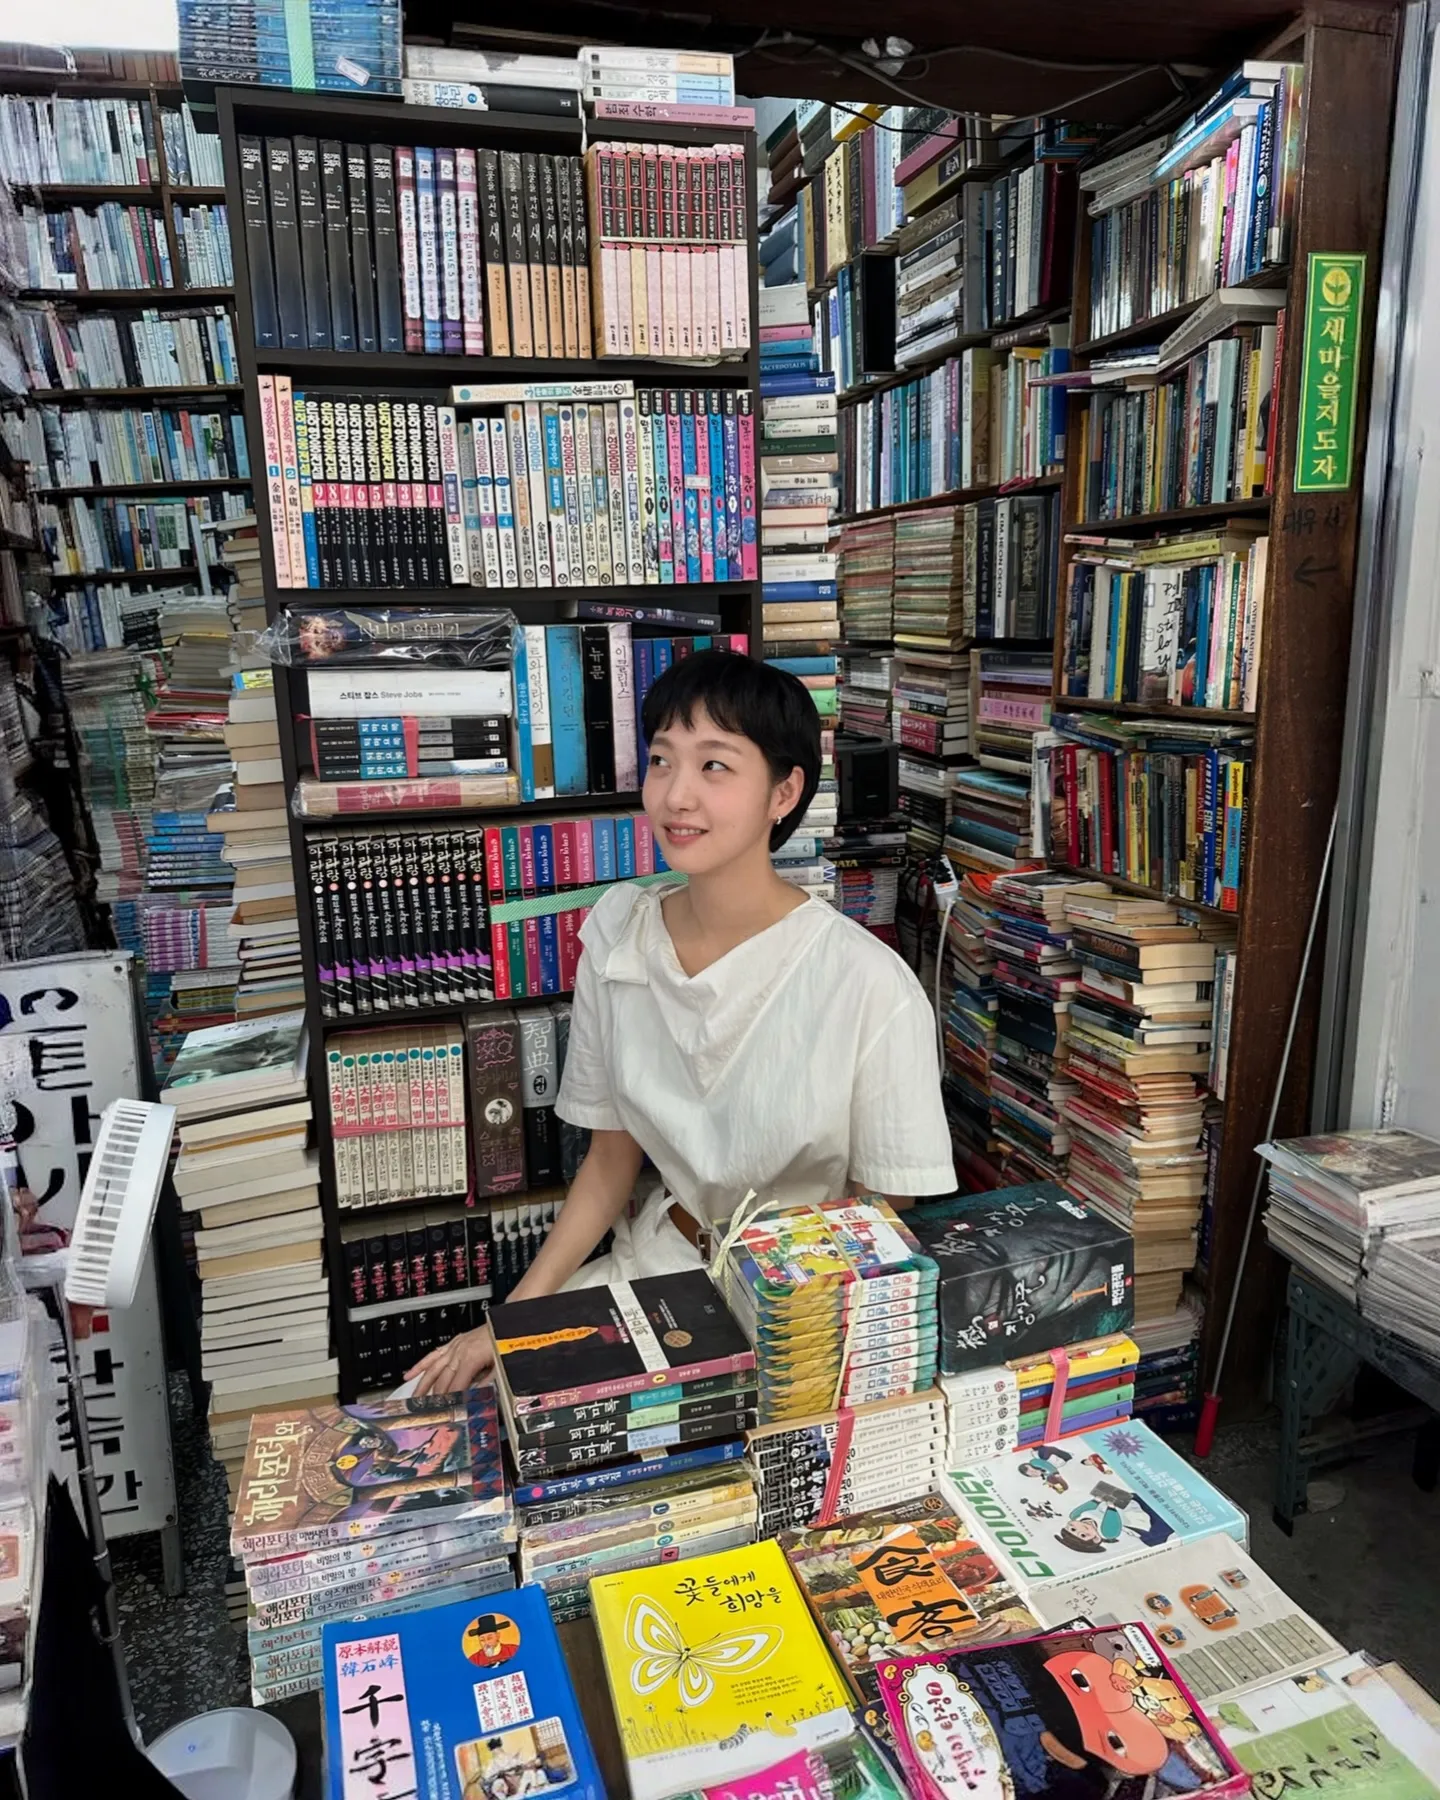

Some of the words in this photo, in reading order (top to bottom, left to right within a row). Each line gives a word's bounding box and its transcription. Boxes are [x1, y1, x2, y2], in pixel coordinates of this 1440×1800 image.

[632, 104, 656, 117] 수학
[489, 222, 500, 245] 새
[511, 222, 522, 245] 새
[530, 222, 541, 246] 새
[546, 224, 557, 247] 새
[576, 225, 587, 248] 새
[1311, 315, 1346, 481] 새마을지도자
[1247, 601, 1258, 673] ONDERHANDELEN
[589, 646, 605, 681] 뉴문
[615, 645, 632, 699] 이클립스
[529, 646, 545, 716] 트와일라잇
[339, 691, 363, 700] 스티브
[364, 691, 380, 700] 잡스
[380, 690, 401, 700] Steve
[402, 690, 423, 700] Jobs
[308, 845, 323, 884] 아리랑
[373, 839, 388, 879] 아리랑
[389, 838, 403, 878] 아리랑
[404, 837, 418, 877] 아리랑
[420, 835, 435, 875] 아리랑
[436, 834, 450, 874] 아리랑
[452, 833, 466, 872] 아리랑
[469, 832, 482, 872] 아리랑
[493, 863, 501, 886] 이야기
[509, 862, 518, 886] 이야기
[525, 861, 533, 885] 이야기
[541, 858, 549, 883] 이야기
[522, 1021, 554, 1074] 智典
[536, 1109, 547, 1124] 3
[573, 1399, 619, 1421] 퇴마록
[568, 1420, 616, 1441] 퇴마록
[569, 1440, 616, 1460] 퇴마록
[243, 1420, 302, 1526] 해리포터와
[547, 1479, 582, 1495] 퇴마록
[946, 1470, 1056, 1579] 다이어터
[242, 1532, 298, 1550] 해리포터와
[299, 1527, 330, 1541] 마법사의
[316, 1553, 341, 1566] 비밀의
[343, 1551, 353, 1560] 방
[321, 1569, 344, 1582] 비밀의
[347, 1568, 357, 1577] 방
[266, 1593, 321, 1616] 해리포터와
[325, 1581, 365, 1597] 아즈카반의
[367, 1575, 383, 1589] 죄수
[674, 1570, 757, 1607] 꽃들에게
[719, 1586, 782, 1613] 희망을
[876, 1584, 911, 1600] 대한민국
[259, 1607, 314, 1629] 해리포터와
[317, 1597, 358, 1613] 아즈카반의
[360, 1593, 375, 1604] 죄수
[340, 1655, 398, 1678] 韓石峰
